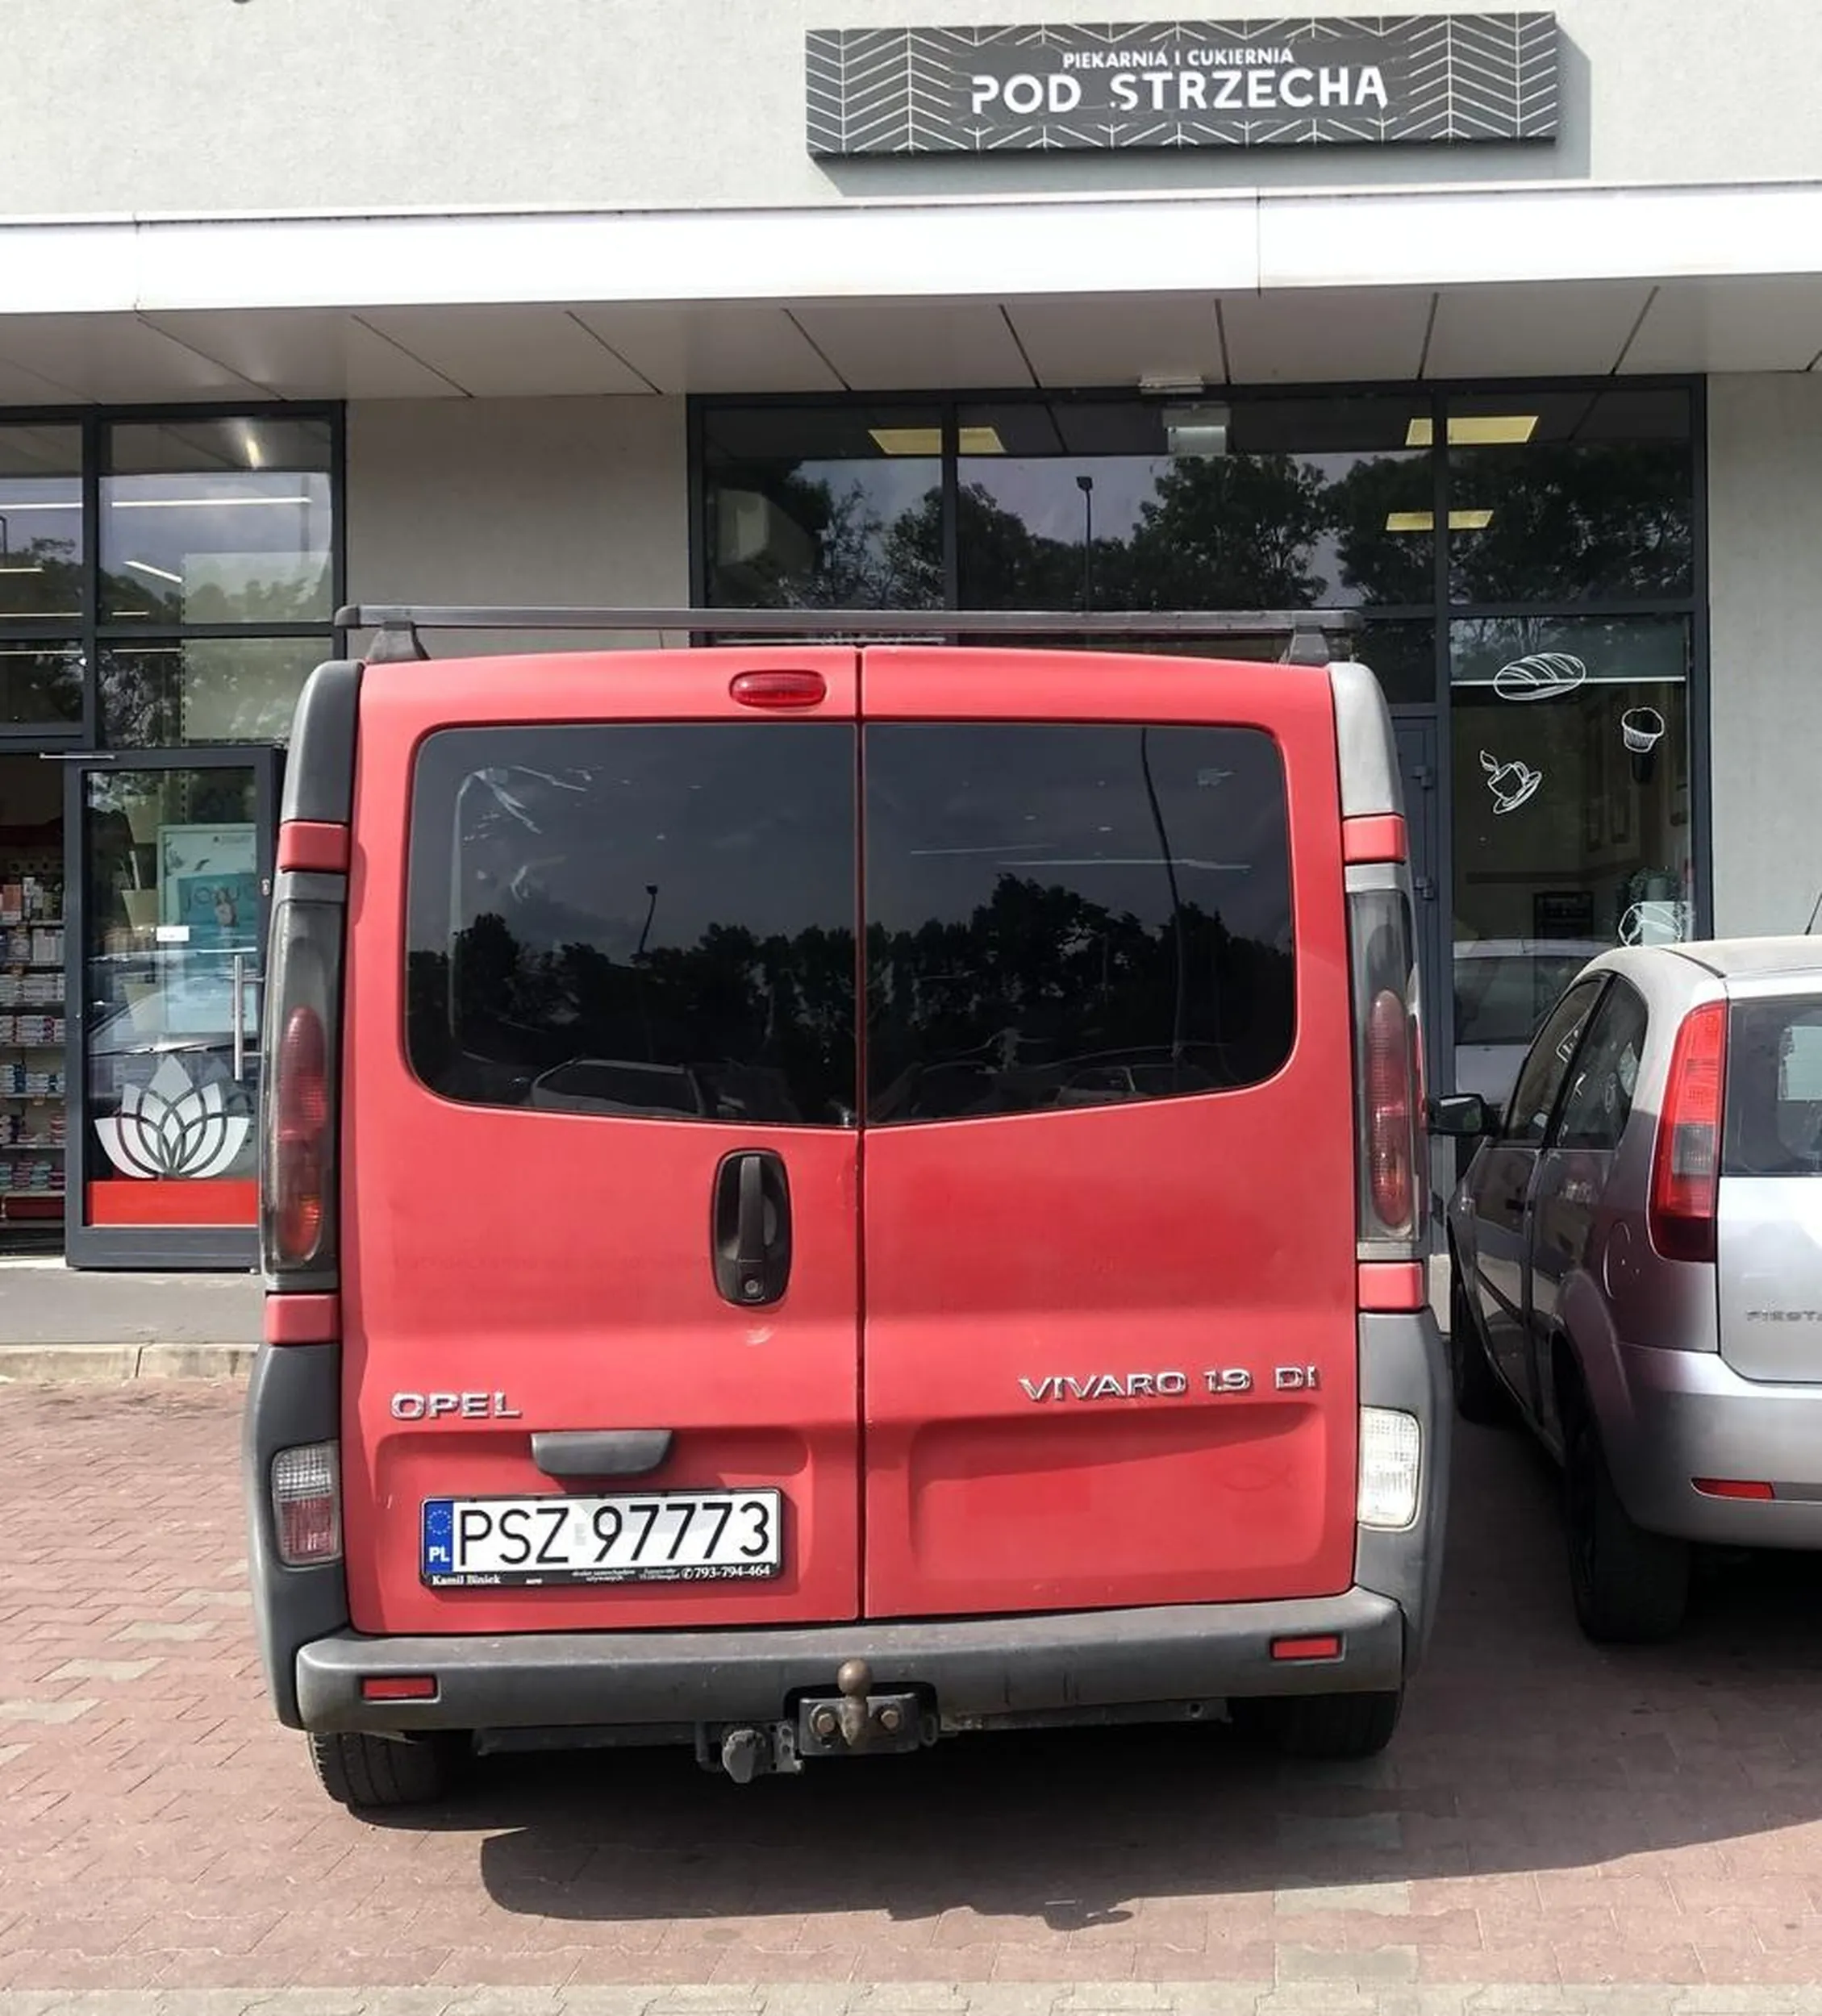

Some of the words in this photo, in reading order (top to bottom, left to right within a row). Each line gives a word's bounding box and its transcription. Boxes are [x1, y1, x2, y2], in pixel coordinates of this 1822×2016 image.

[1061, 49, 1169, 69] PIEKARNIA
[1174, 48, 1180, 66] I
[1186, 47, 1295, 66] CUKIERNIA
[971, 73, 1082, 114] POD
[1018, 1370, 1186, 1402] VIVARO
[1275, 1364, 1316, 1389] DI
[391, 1389, 523, 1419] OPEL
[459, 1507, 569, 1566] PSZ
[592, 1500, 769, 1563] 97773
[428, 1546, 450, 1563] PL
[432, 1575, 464, 1585] Kamil
